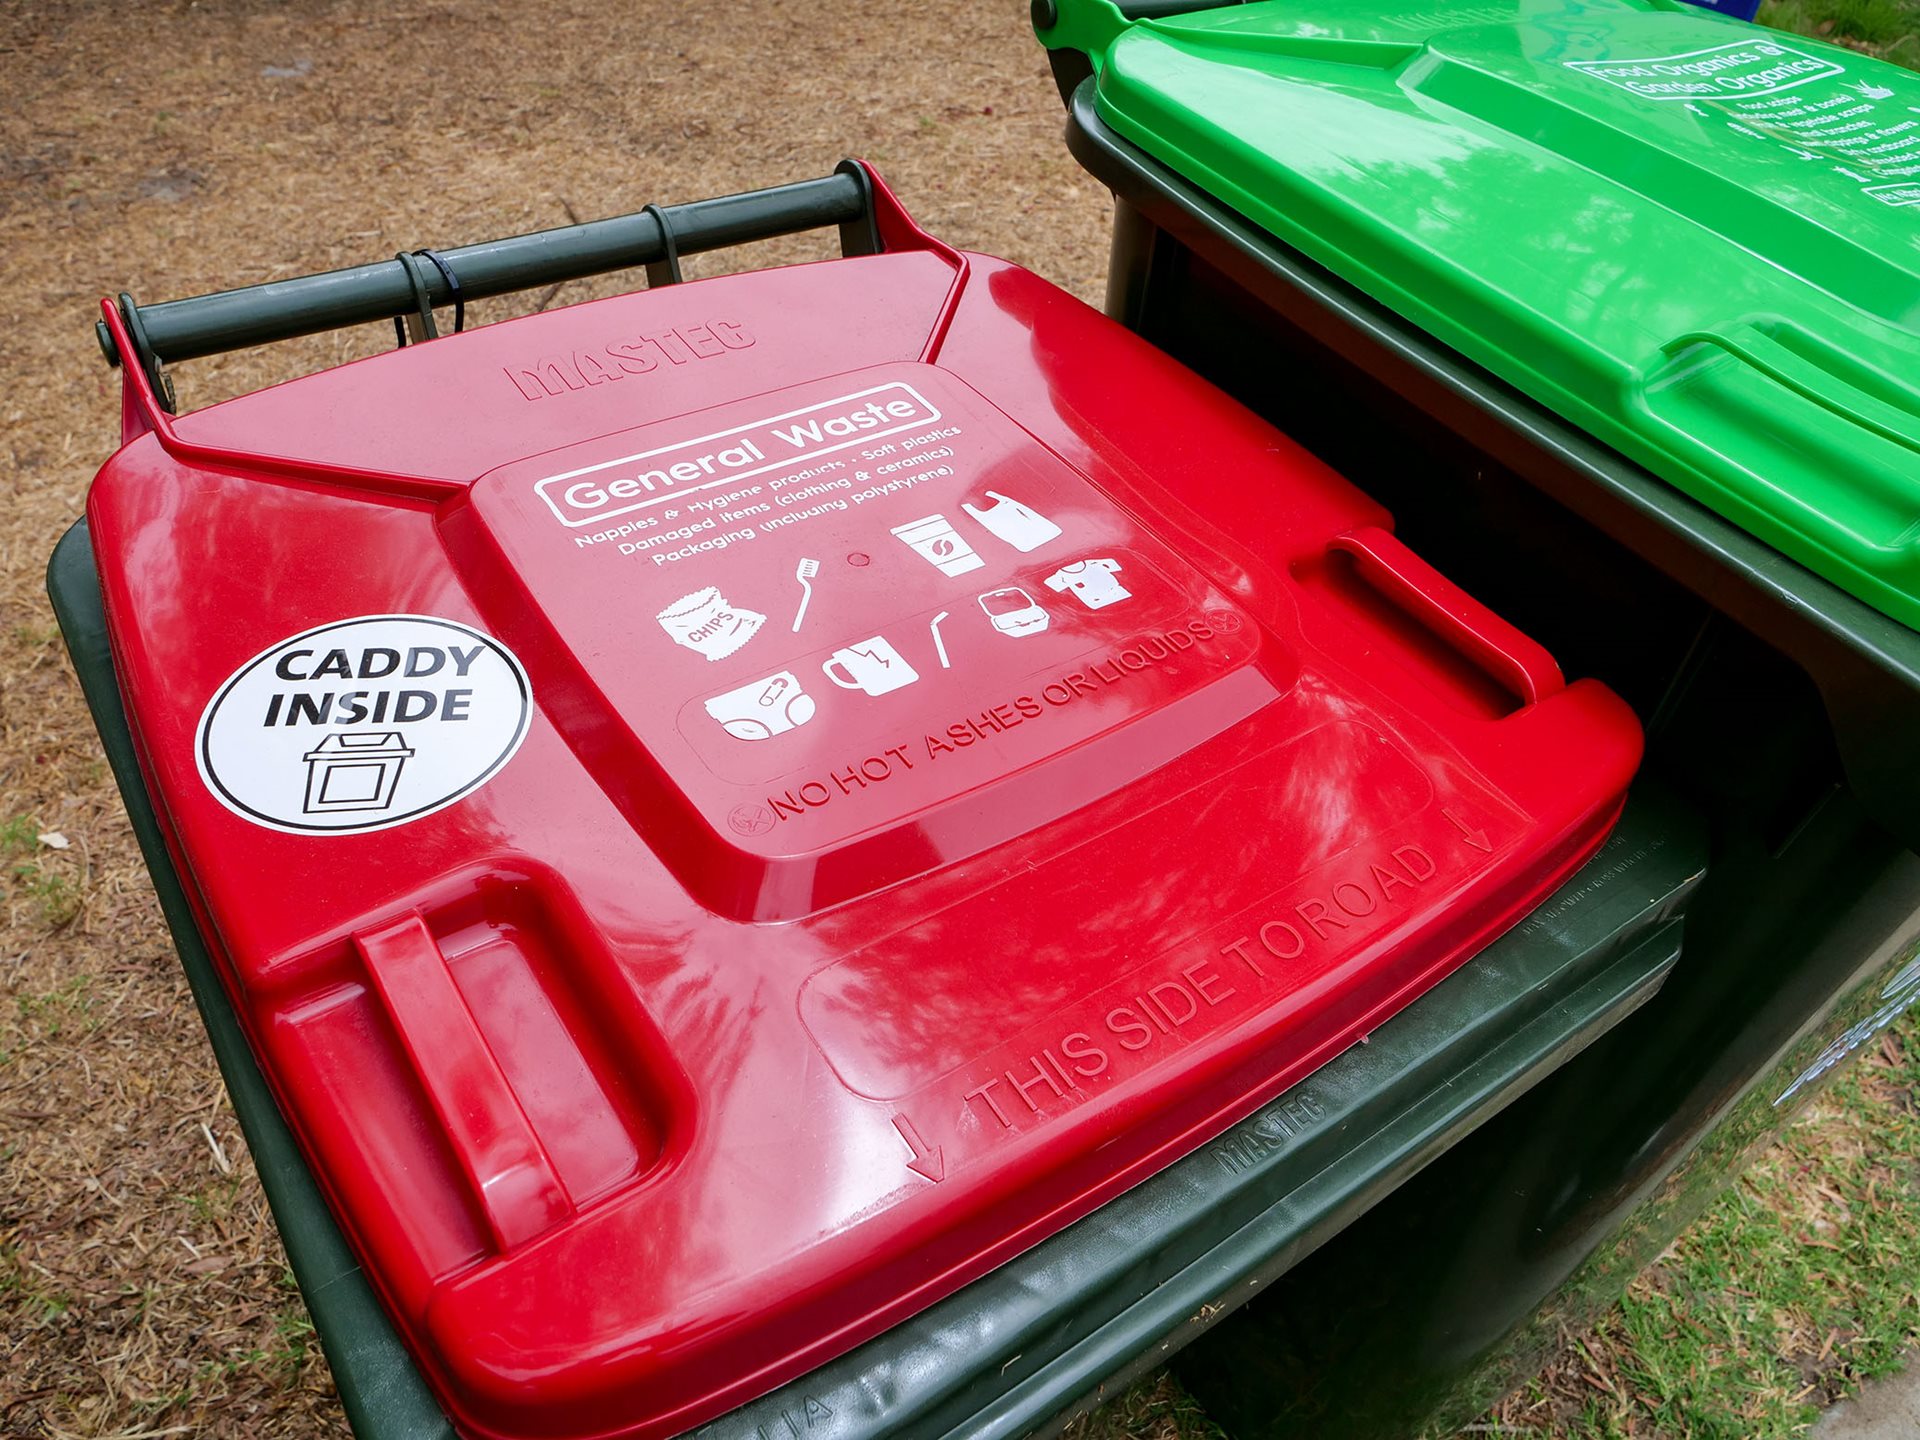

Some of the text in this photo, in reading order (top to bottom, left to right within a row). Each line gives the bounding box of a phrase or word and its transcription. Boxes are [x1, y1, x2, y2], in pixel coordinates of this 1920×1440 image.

[1580, 44, 1786, 78] Food Organics &
[1624, 58, 1826, 94] Garden Organics
[502, 317, 758, 402] MASTEC
[563, 395, 918, 511] General Waste
[574, 425, 962, 549] Nappies & Hygiene products Soft plastics
[617, 444, 955, 556] Damaged items (clothing & ceramics)
[651, 463, 955, 567] Packaging (including polystyrene)
[274, 645, 488, 682] CADDY
[687, 611, 735, 643] CHIPS
[262, 688, 475, 728] INSIDE
[765, 619, 1216, 823] NO HOT ASHES OR LIQUIDS
[961, 841, 1439, 1131] THIS SIDE TO ROAD
[1208, 1090, 1327, 1177] MASTEC
